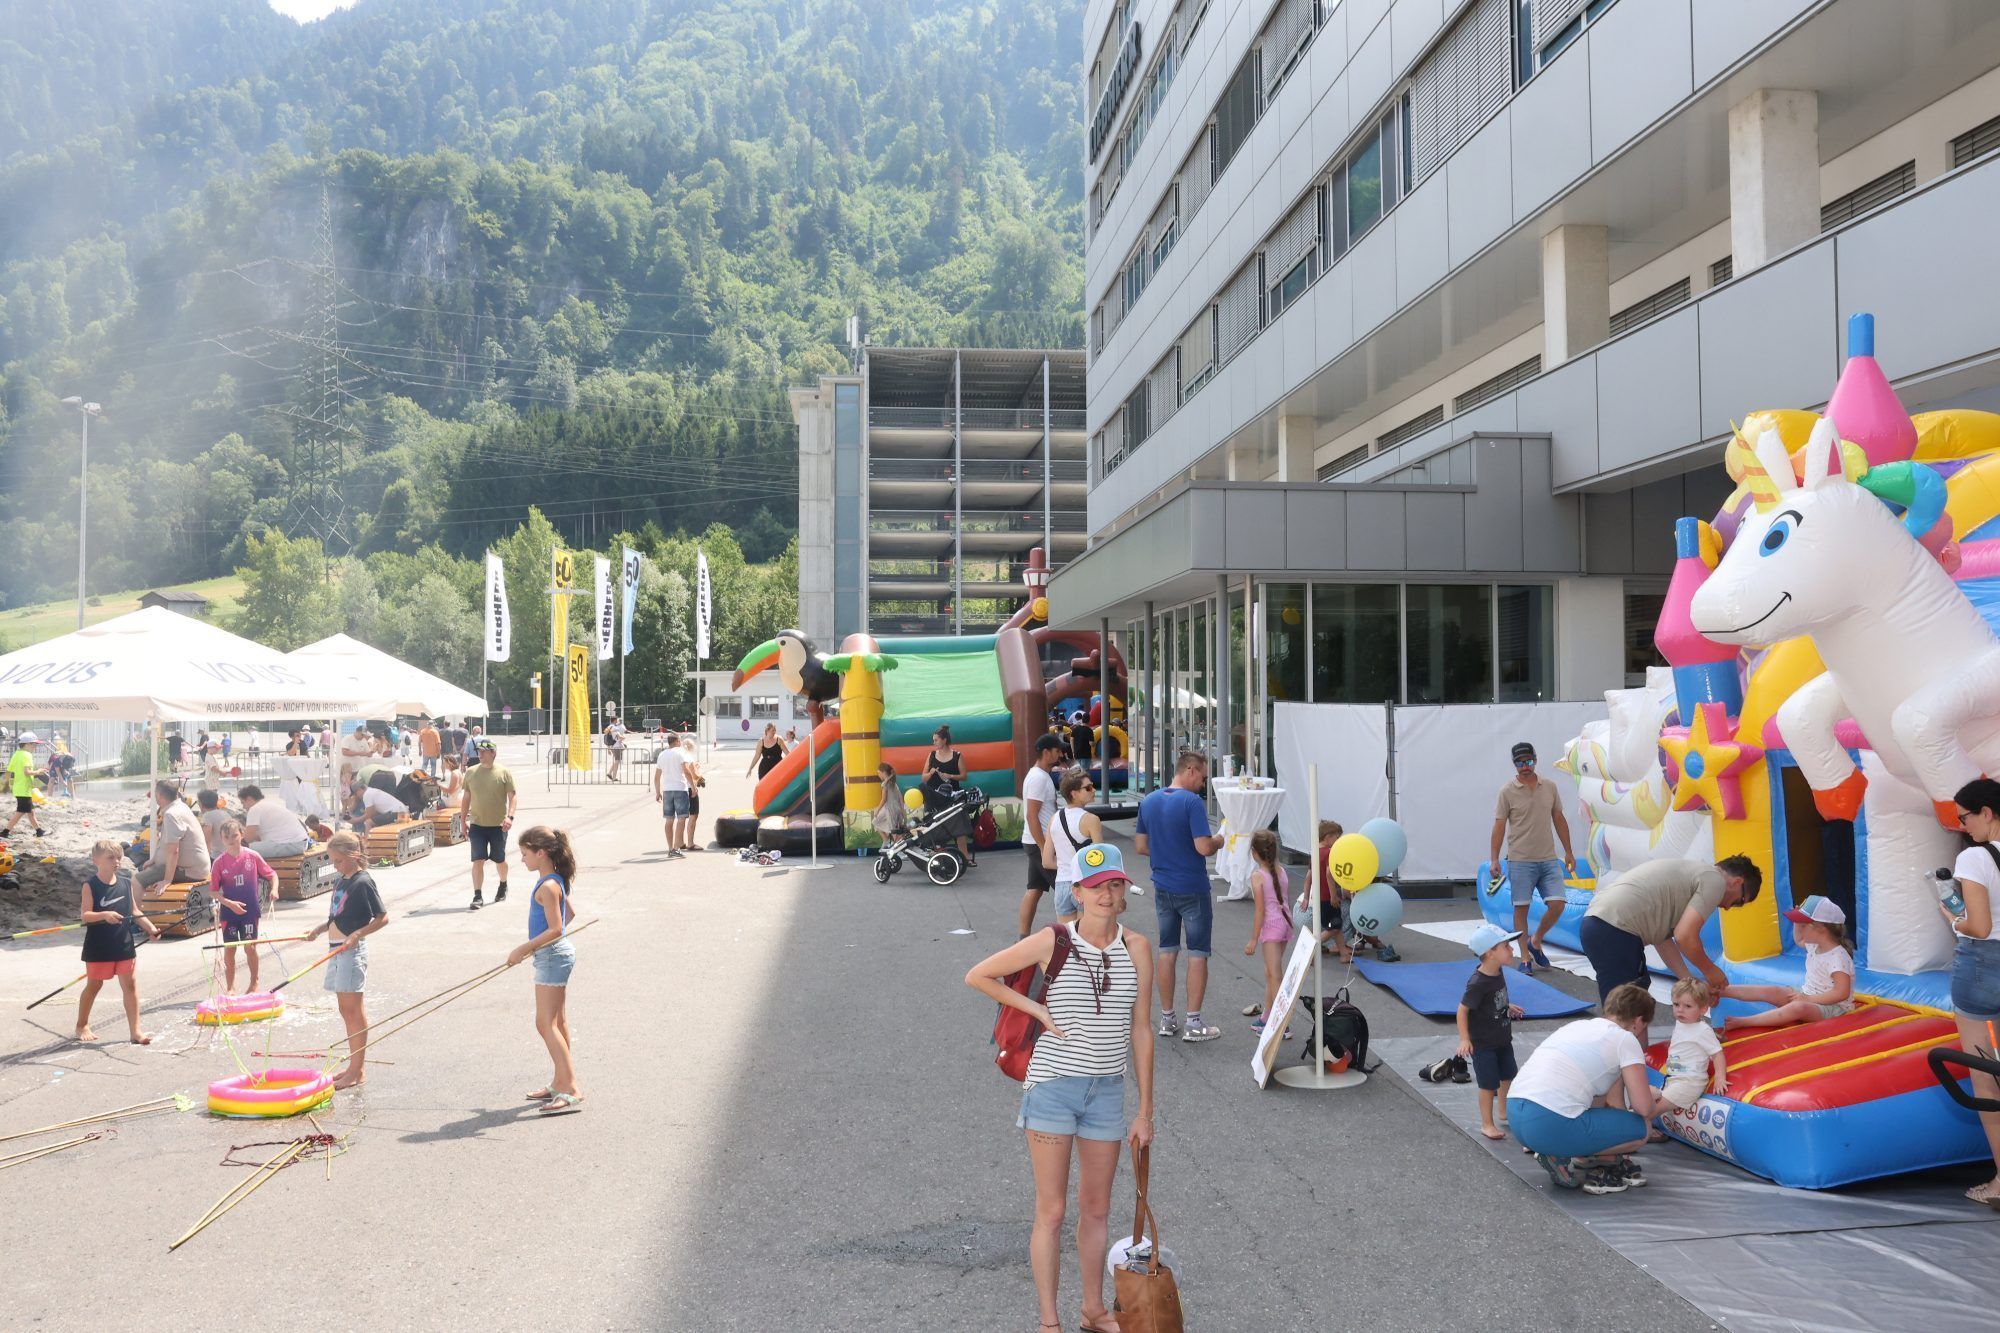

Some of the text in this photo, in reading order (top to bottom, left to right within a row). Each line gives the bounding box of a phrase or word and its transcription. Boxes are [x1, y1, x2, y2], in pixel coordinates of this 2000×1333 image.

[555, 556, 571, 588] 50
[625, 556, 639, 587] 50
[571, 653, 583, 683] 50
[206, 703, 222, 713] AUS
[225, 702, 276, 713] VORARLBERG
[283, 702, 305, 712] NICHT
[307, 702, 321, 712] VON
[322, 703, 359, 713] IRGENDWO
[1335, 862, 1353, 877] 50
[233, 874, 245, 886] 10
[244, 924, 254, 934] 10
[1357, 914, 1379, 930] 50
